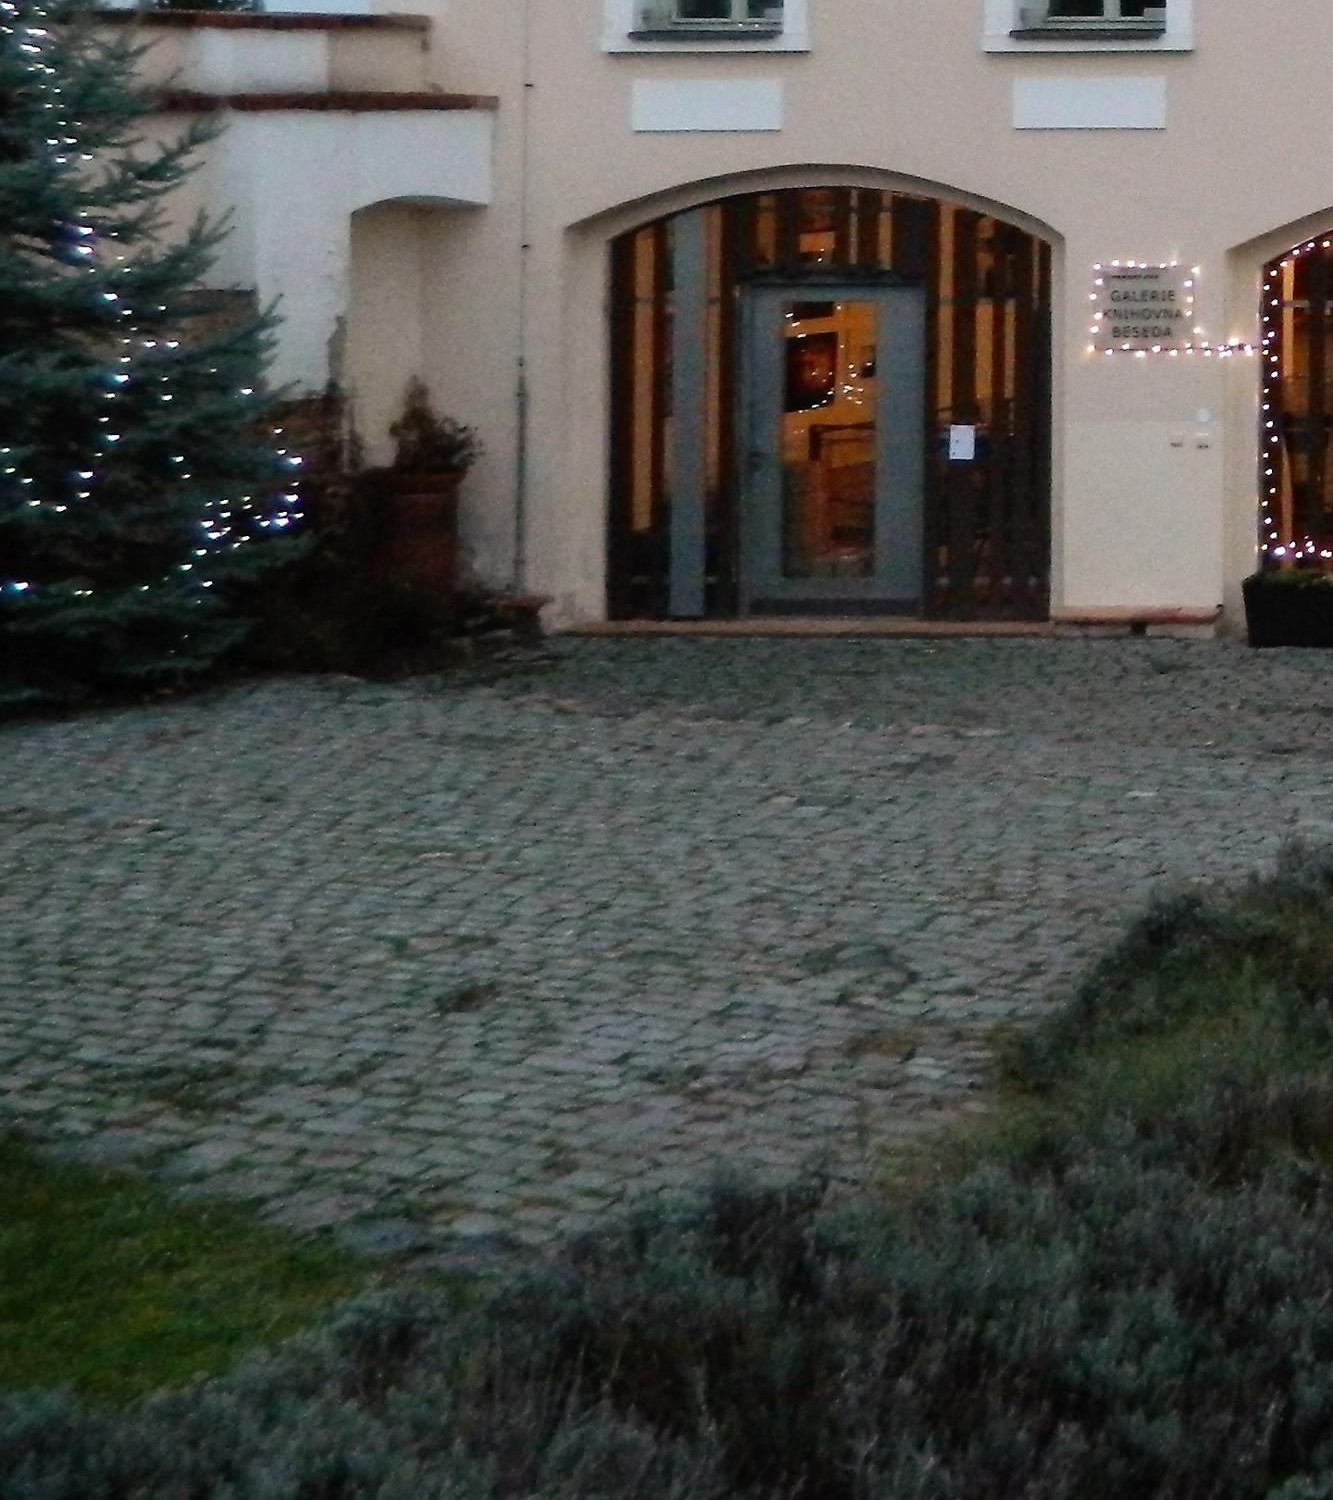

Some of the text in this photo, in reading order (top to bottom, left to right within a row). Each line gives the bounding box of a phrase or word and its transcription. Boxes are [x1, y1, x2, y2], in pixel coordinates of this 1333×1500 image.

[1110, 290, 1176, 303] GALERIE
[1103, 308, 1182, 320] KNIHOVNA
[1111, 326, 1172, 338] BESEDA
